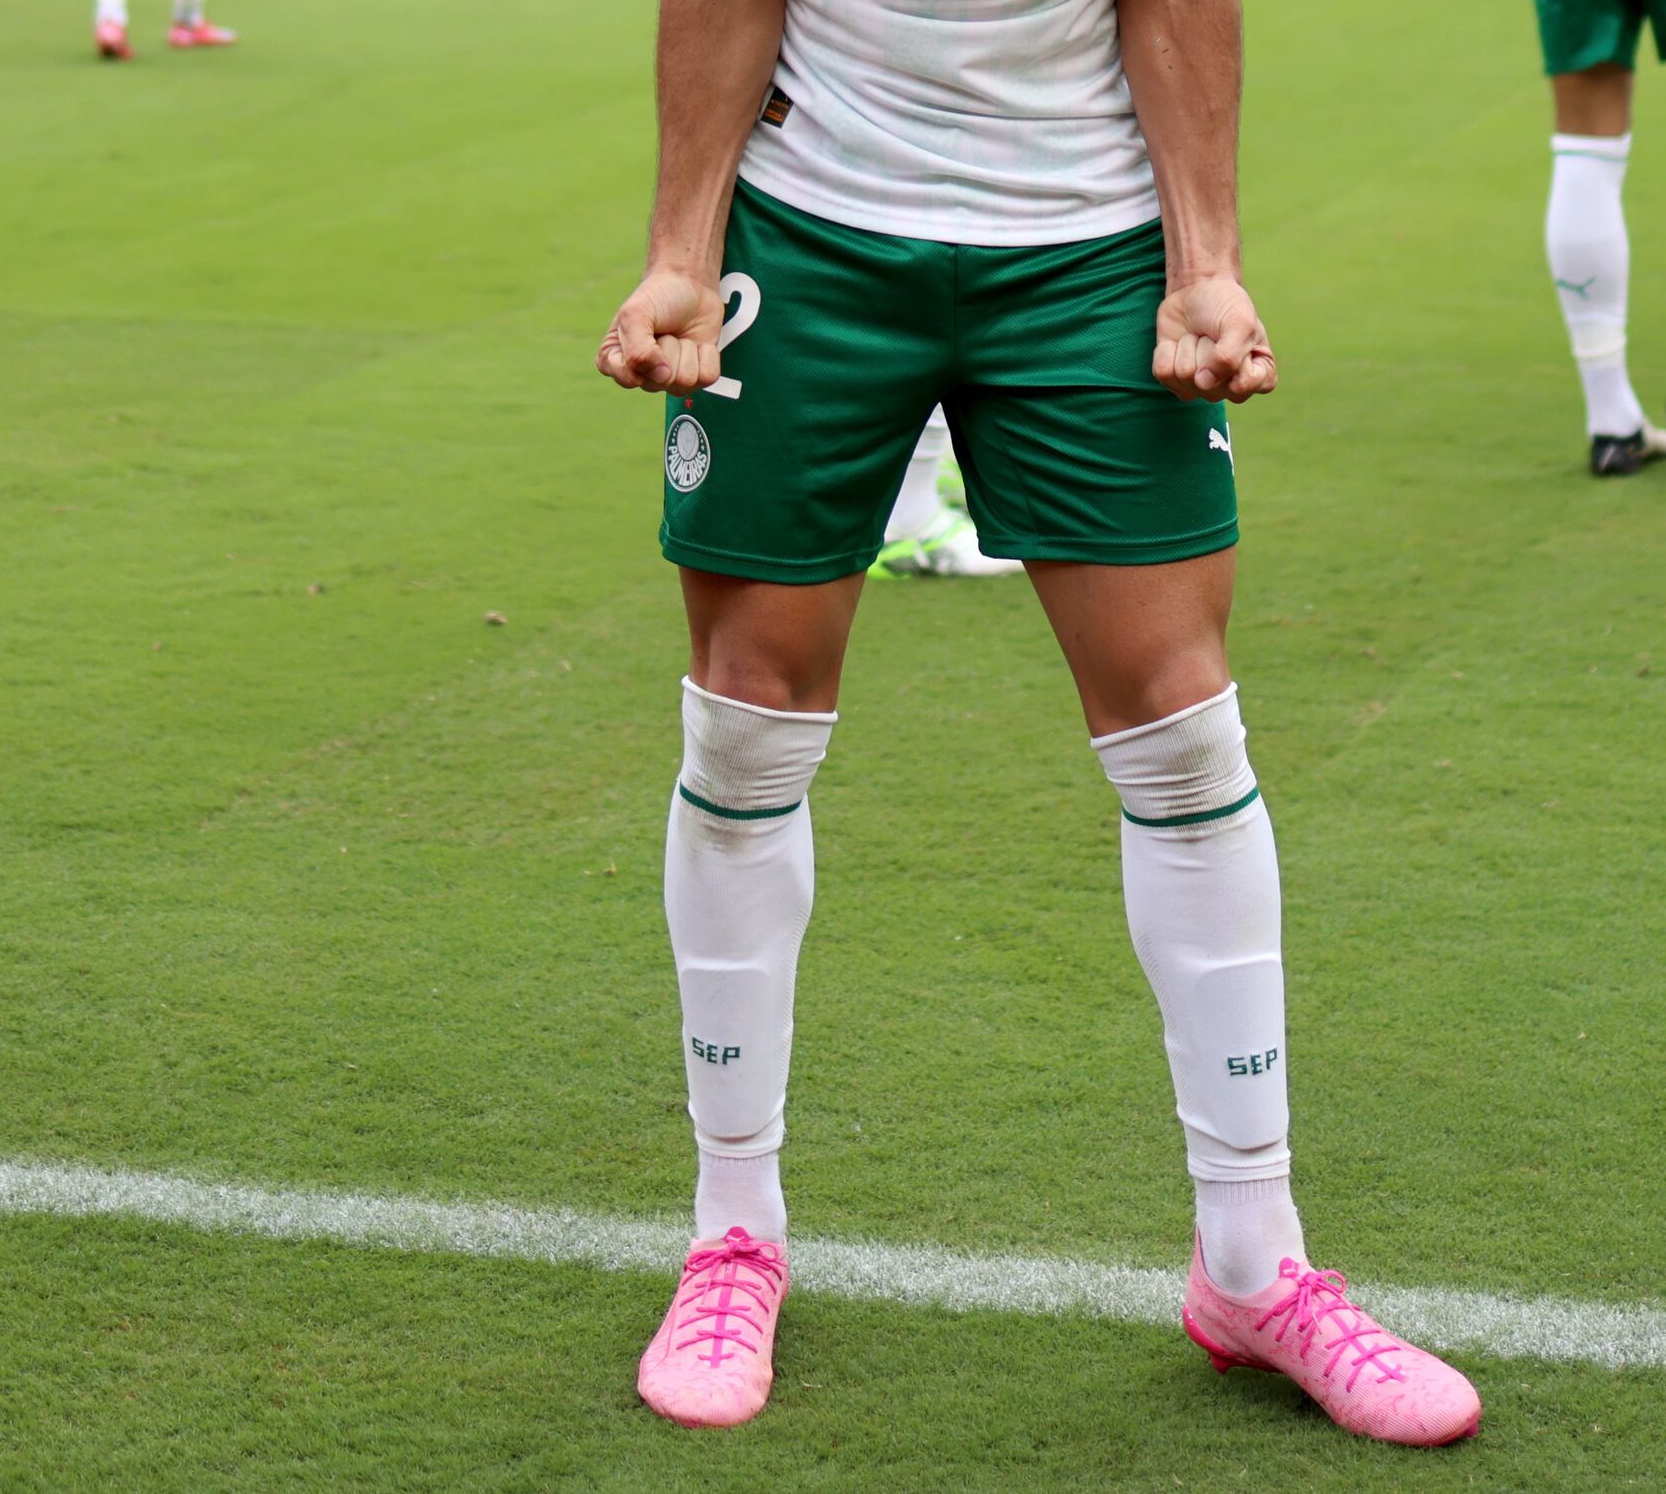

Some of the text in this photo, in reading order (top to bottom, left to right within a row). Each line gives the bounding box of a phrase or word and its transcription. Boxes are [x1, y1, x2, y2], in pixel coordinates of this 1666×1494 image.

[668, 444, 707, 488] PALMEIRAS
[691, 1036, 741, 1066] SEP
[1227, 1047, 1278, 1076] SEP
